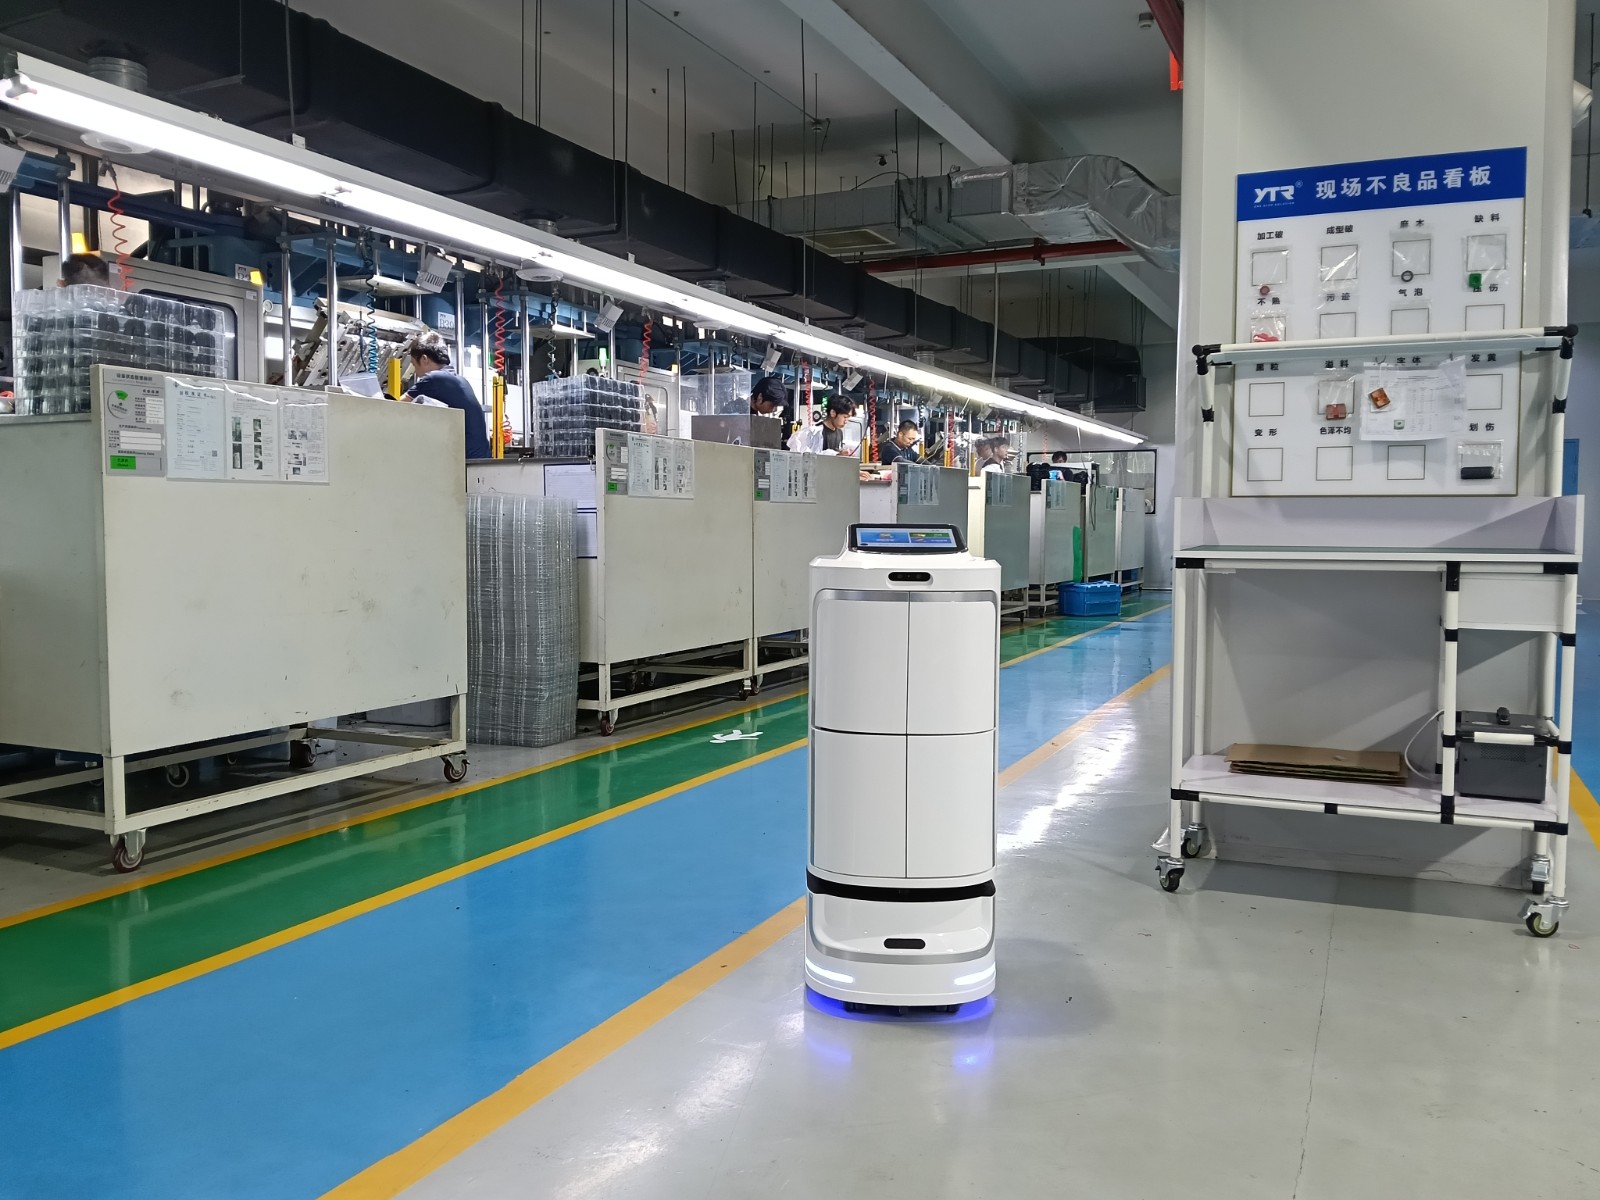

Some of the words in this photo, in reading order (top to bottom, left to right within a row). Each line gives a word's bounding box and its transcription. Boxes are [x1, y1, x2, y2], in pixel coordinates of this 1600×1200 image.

[1316, 165, 1491, 199] 现场不良品看板
[1398, 288, 1423, 296] 气泡
[1471, 353, 1497, 362] 发黄
[1320, 427, 1351, 435] 色泽不均
[1469, 423, 1495, 431] 划伤
[1254, 428, 1278, 437] 变形
